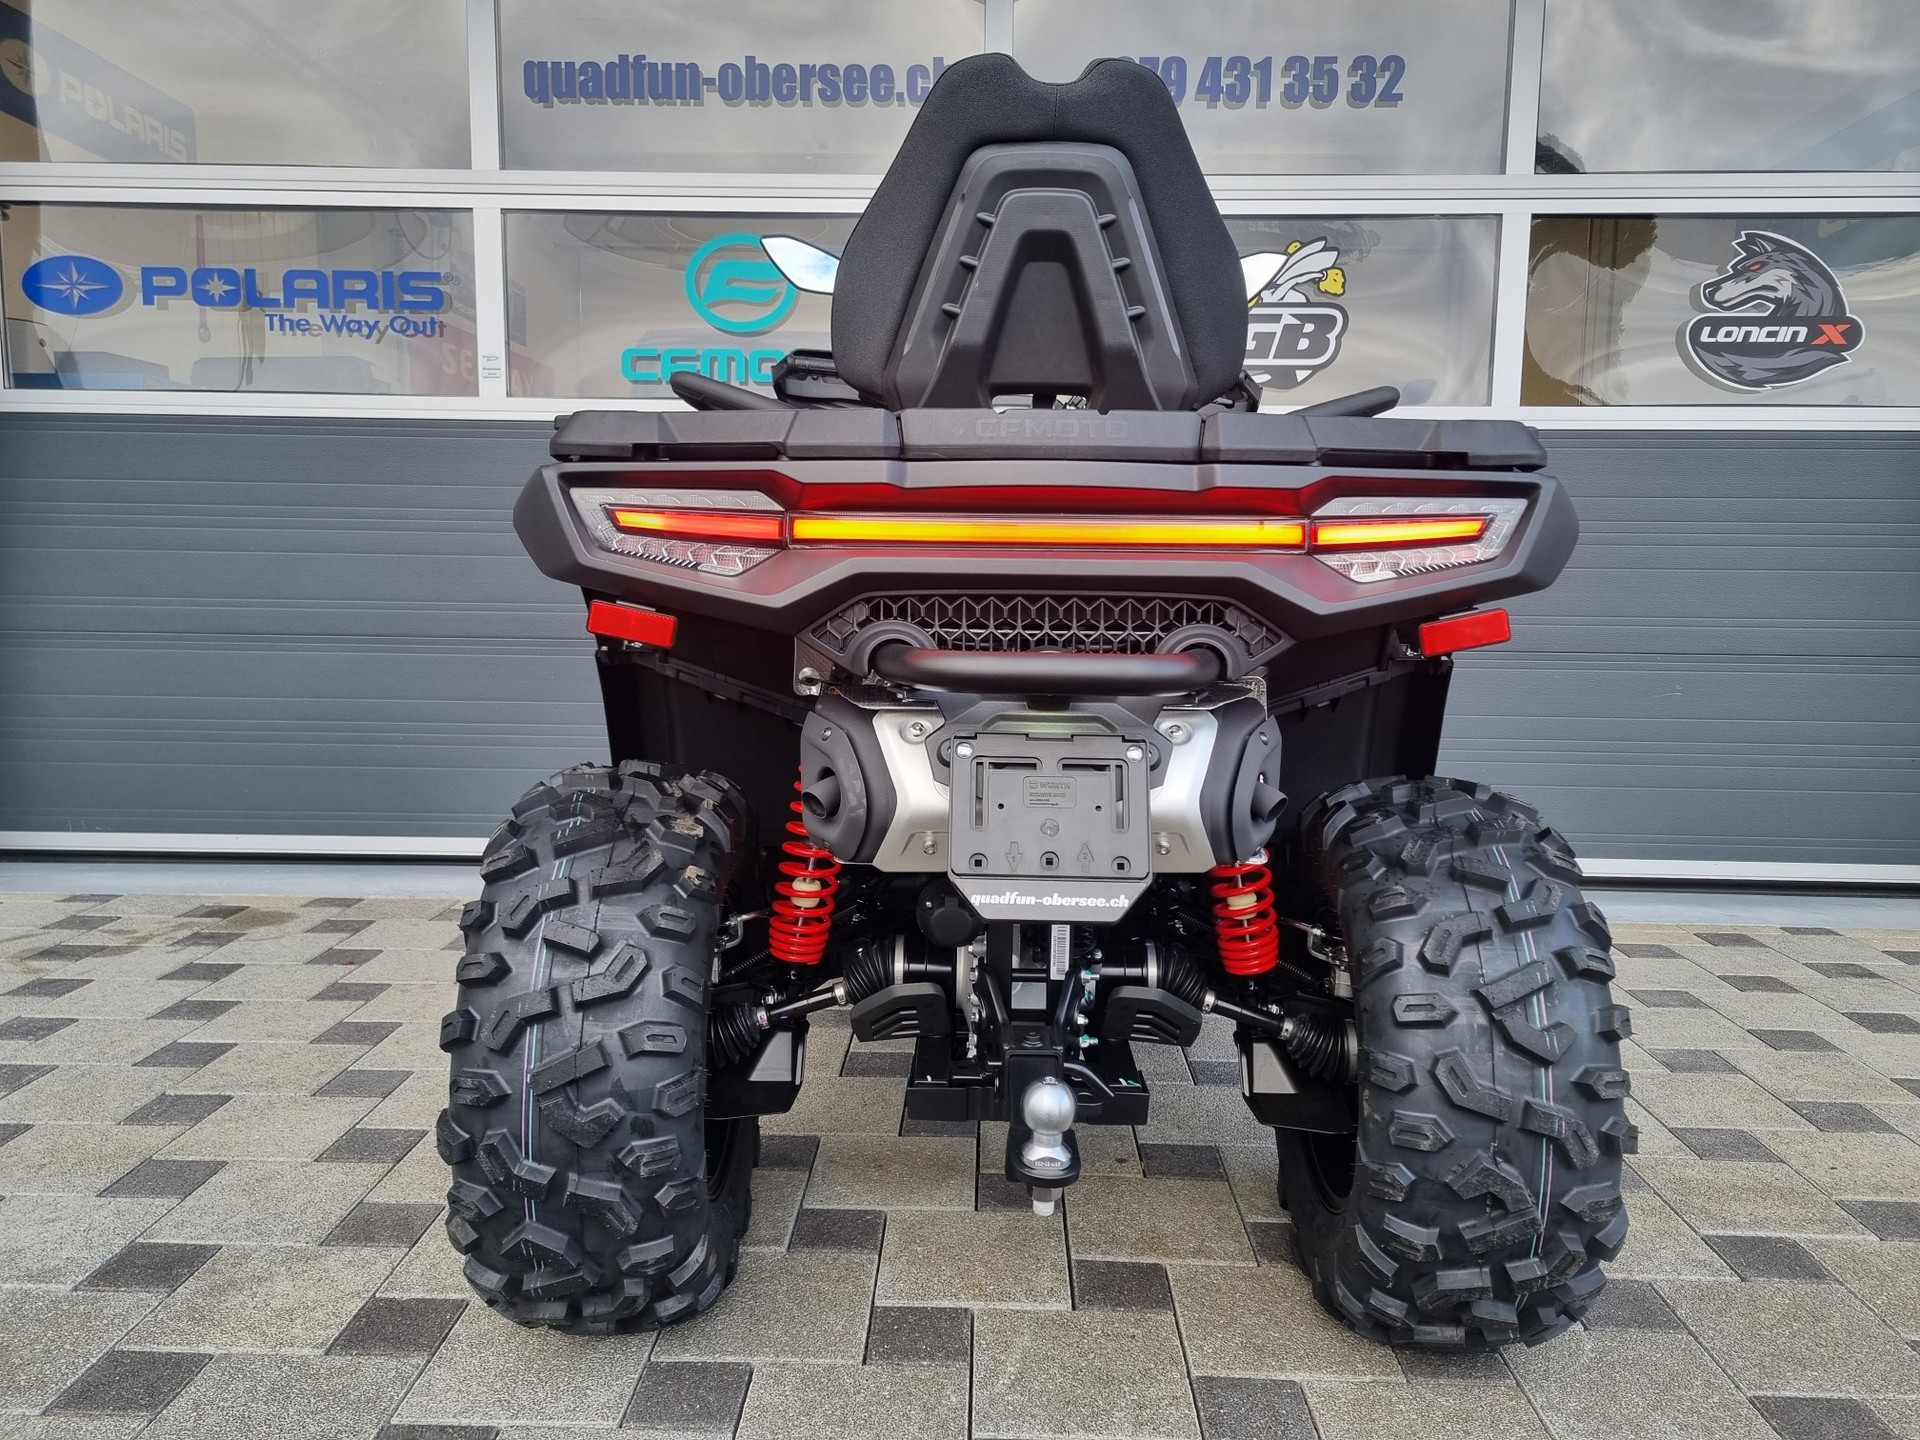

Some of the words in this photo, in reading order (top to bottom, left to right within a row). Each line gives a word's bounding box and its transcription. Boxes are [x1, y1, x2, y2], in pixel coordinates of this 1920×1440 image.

[1197, 55, 1273, 103] 431
[1284, 55, 1339, 103] 35
[1351, 55, 1406, 103] 32
[58, 69, 187, 163] POLARIS
[141, 266, 445, 310] POLARIS
[264, 313, 310, 333] The
[319, 314, 380, 340] Way
[389, 315, 443, 336] Out
[1246, 313, 1337, 360] GB
[1810, 324, 1851, 345] X
[621, 348, 786, 382] CFMO
[975, 418, 1130, 439] CFMOTO
[970, 892, 1129, 909] quadfun-obersee.ch
